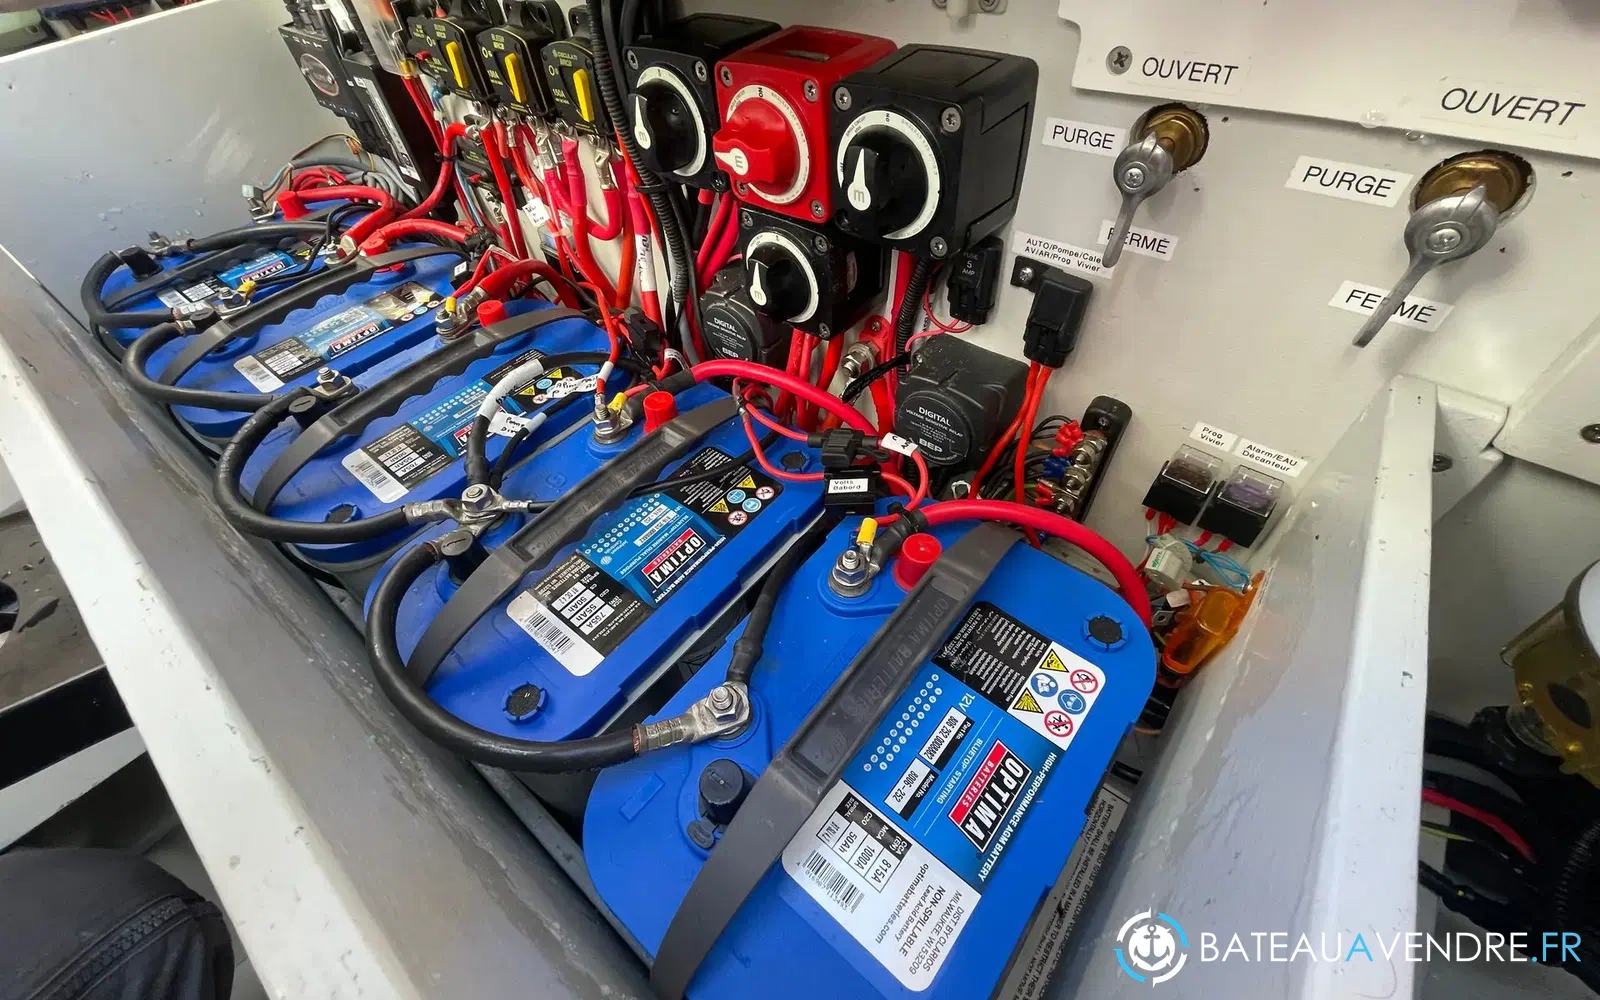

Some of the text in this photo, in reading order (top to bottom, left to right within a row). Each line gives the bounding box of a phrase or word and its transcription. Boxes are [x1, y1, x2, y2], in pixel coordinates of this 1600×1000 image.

[1142, 57, 1238, 85] OUVERT
[1441, 88, 1585, 126] OUVERT
[1052, 125, 1115, 150] PURGE
[1302, 165, 1396, 198] PURGE
[966, 260, 972, 268] 5
[1025, 246, 1100, 272] AV/AR/Prog Vivier
[1026, 238, 1102, 264] AUTO/Pompe/Cale
[1345, 289, 1437, 323] FEMÉ
[333, 325, 376, 350] OPTIMA
[917, 406, 951, 426] DIGITAL
[918, 437, 943, 453] BEP
[1200, 433, 1225, 447] Vivier
[1242, 450, 1291, 473] Décanteur
[1246, 444, 1298, 467] Alarm/EAU
[648, 534, 702, 583] OPTIMA
[567, 595, 587, 613] 50Ah
[575, 602, 597, 622] 55Ah
[956, 691, 975, 712] 12V
[920, 773, 935, 790] Model
[935, 769, 962, 804] STARTING
[960, 760, 994, 807] BATTERIES
[964, 759, 1024, 836] OPTIMA
[860, 811, 873, 825] C20
[976, 751, 1057, 882] HIGH-PERFORMANCE AGM BATTERY
[1084, 799, 1106, 840] HORIZONTALLY
[1099, 803, 1114, 829] BATTERY
[837, 830, 858, 854] 50Ah
[875, 824, 888, 840] MCA
[888, 835, 902, 851] (EN)
[1090, 828, 1103, 847] SHALL
[853, 844, 876, 870] 1000A
[895, 840, 907, 855] CCA
[1087, 846, 1095, 856] BE
[870, 858, 892, 884] 815A
[1072, 855, 1091, 888] INSTALLED
[874, 862, 930, 944] optimabatteries.com
[893, 884, 934, 942] Lead Acid Battery
[898, 885, 946, 956] NON-SPILLABLE
[907, 890, 962, 975] MILWAUKEE, WI 53209
[921, 905, 965, 971] DIST. BY CLARIOS
[1049, 928, 1058, 940] TO
[1034, 939, 1054, 975] RESTRICT
[1024, 974, 1039, 997] THEIR
